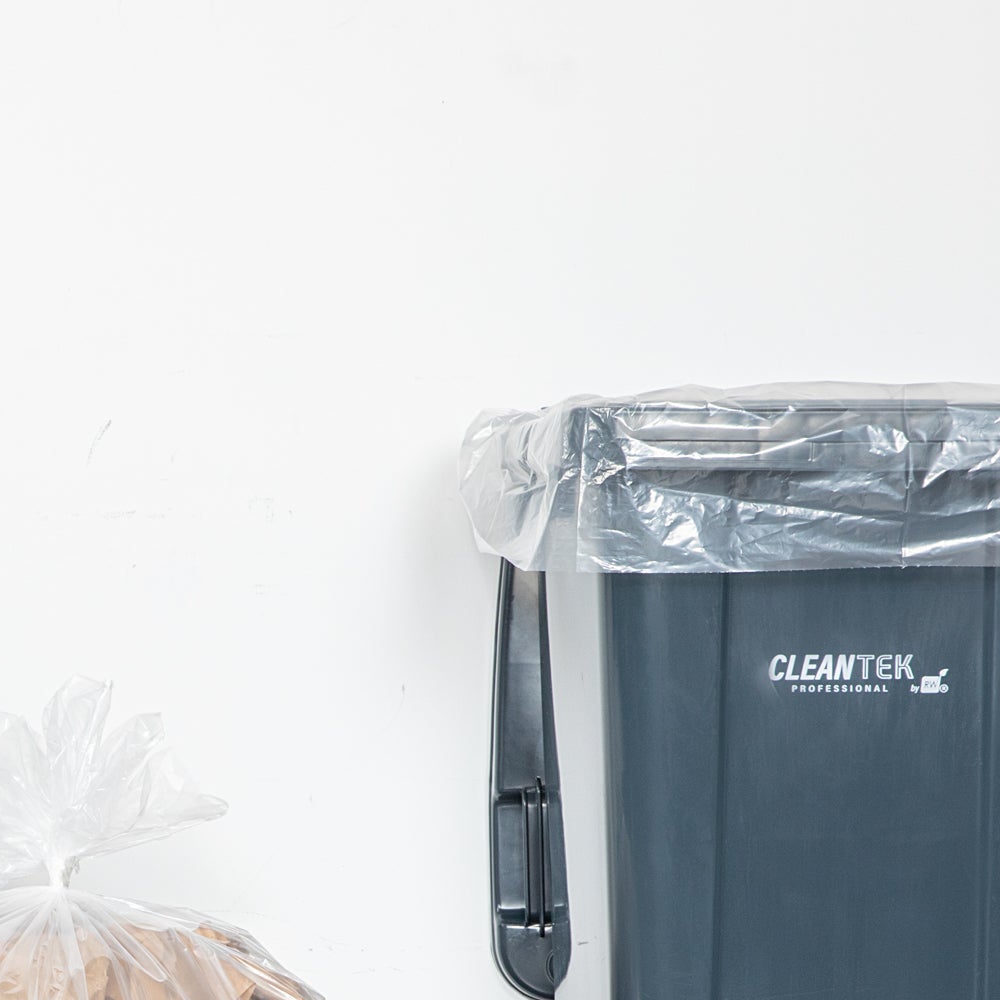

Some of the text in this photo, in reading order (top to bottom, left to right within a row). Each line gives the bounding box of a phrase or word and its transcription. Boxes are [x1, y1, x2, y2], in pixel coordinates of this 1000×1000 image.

[768, 654, 914, 681] CLEANTEK
[791, 684, 889, 693] PROFESSIONAL
[910, 684, 920, 694] by
